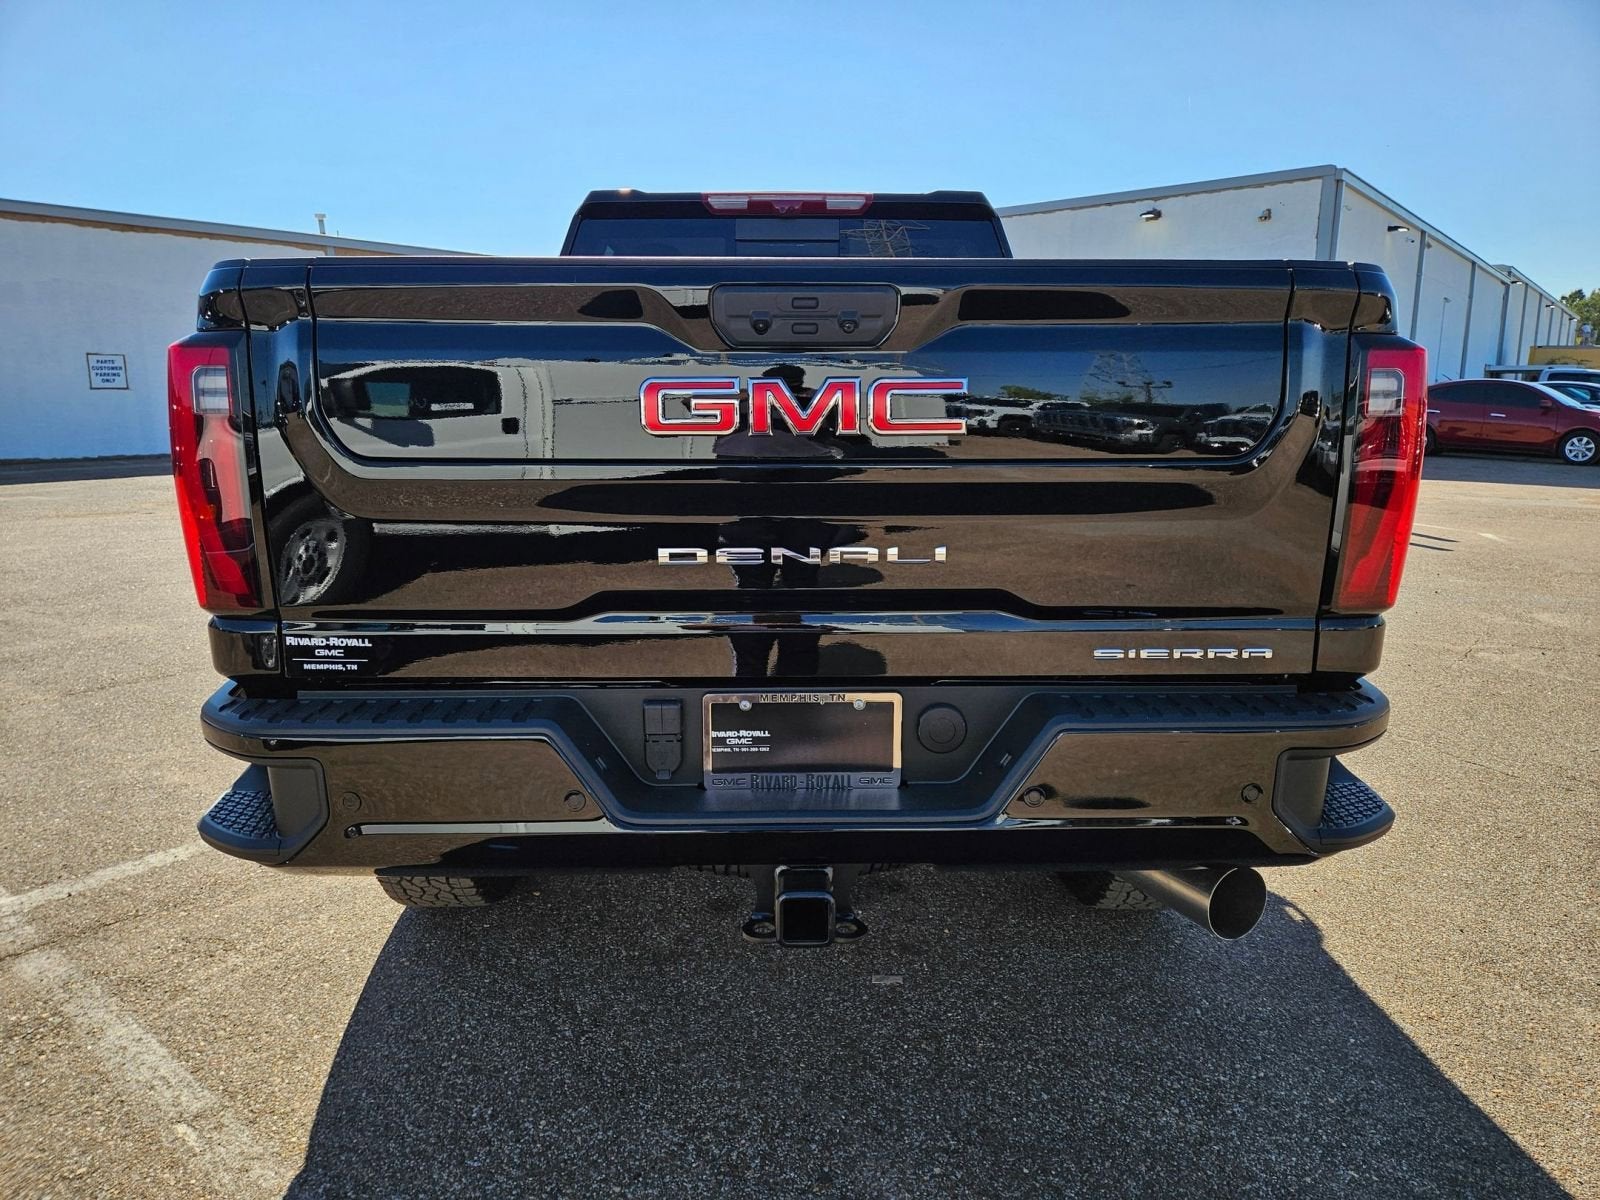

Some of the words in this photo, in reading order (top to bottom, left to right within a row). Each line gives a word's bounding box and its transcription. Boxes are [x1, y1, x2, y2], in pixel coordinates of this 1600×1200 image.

[639, 376, 969, 436] GMC
[657, 546, 947, 566] DENALI
[285, 636, 373, 647] RIVARD-ROYALL
[314, 649, 344, 657] GMC
[1093, 648, 1273, 661] SIERRA
[303, 663, 346, 671] MEMPHIS,
[760, 693, 825, 705] MEMPHIS,
[829, 693, 846, 702] TN
[711, 778, 747, 787] GMC
[858, 776, 893, 787] GMC
